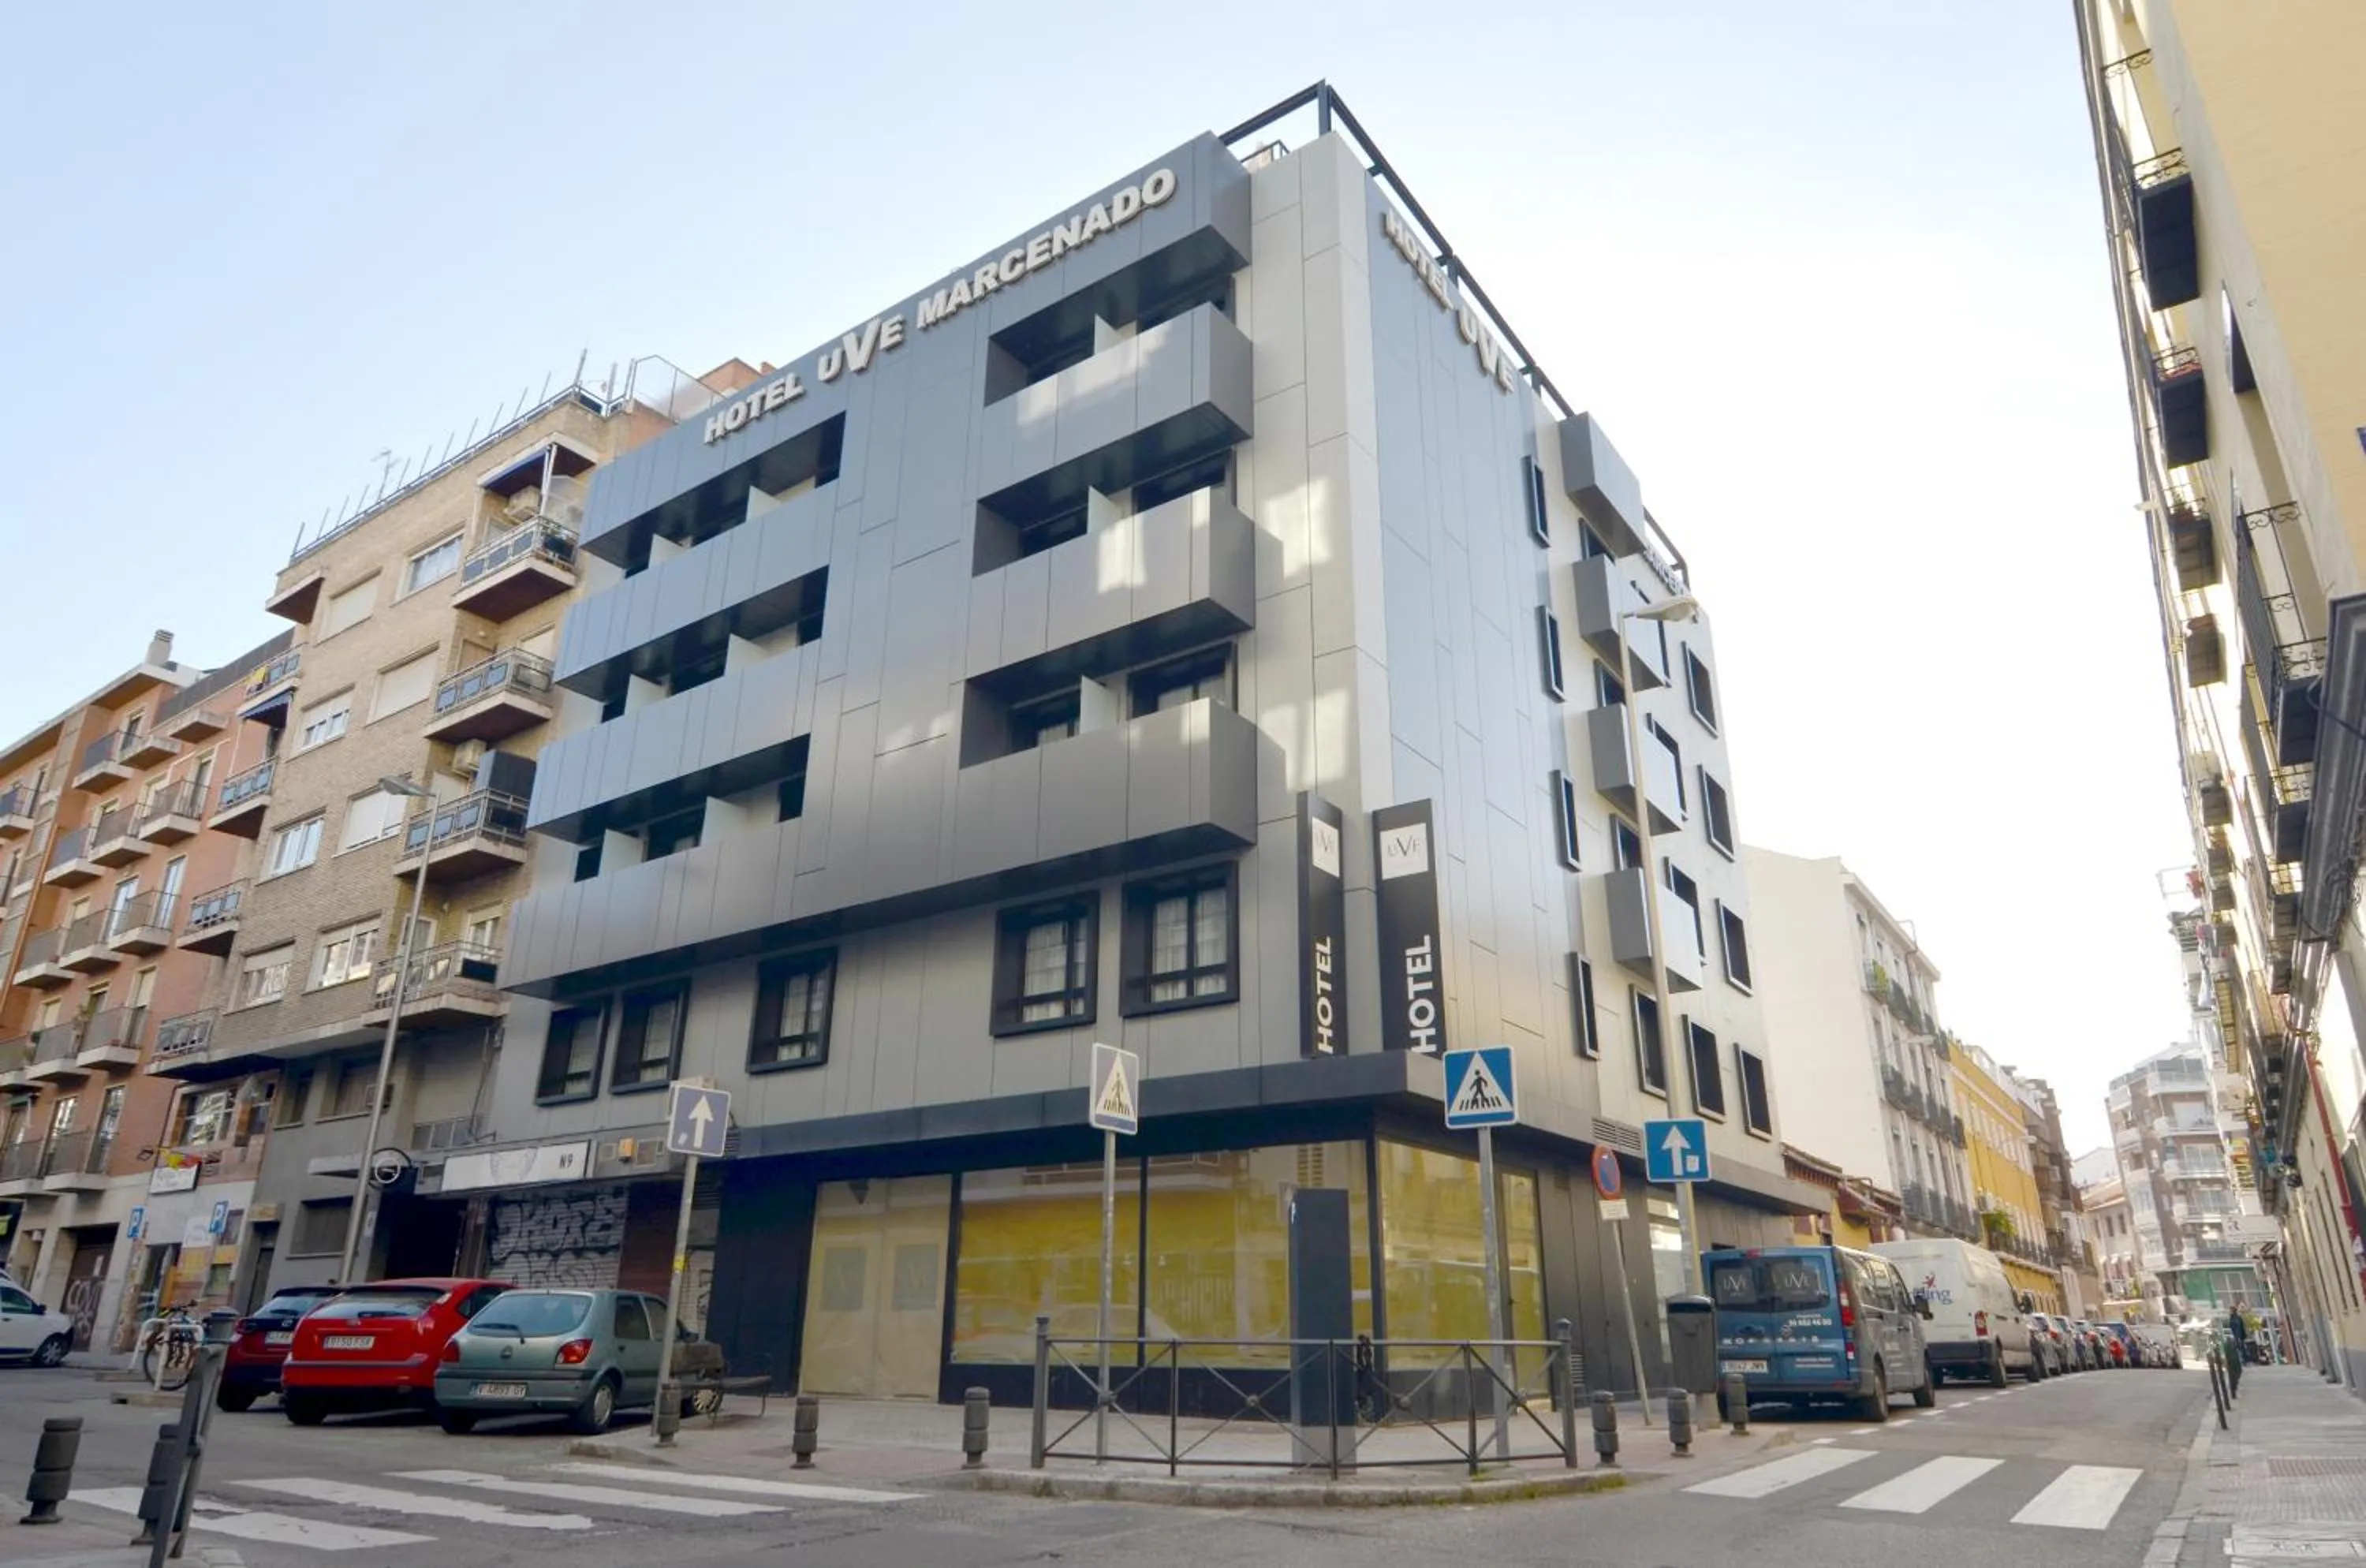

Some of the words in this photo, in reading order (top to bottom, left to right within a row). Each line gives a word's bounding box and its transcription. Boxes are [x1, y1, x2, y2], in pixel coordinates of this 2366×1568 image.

[704, 372, 805, 444] HOTEL
[916, 167, 1177, 330] MARCENADO
[1383, 210, 1454, 312] HOTEL
[1315, 935, 1334, 1055] HOTEL
[1405, 934, 1437, 1055] HOTEL
